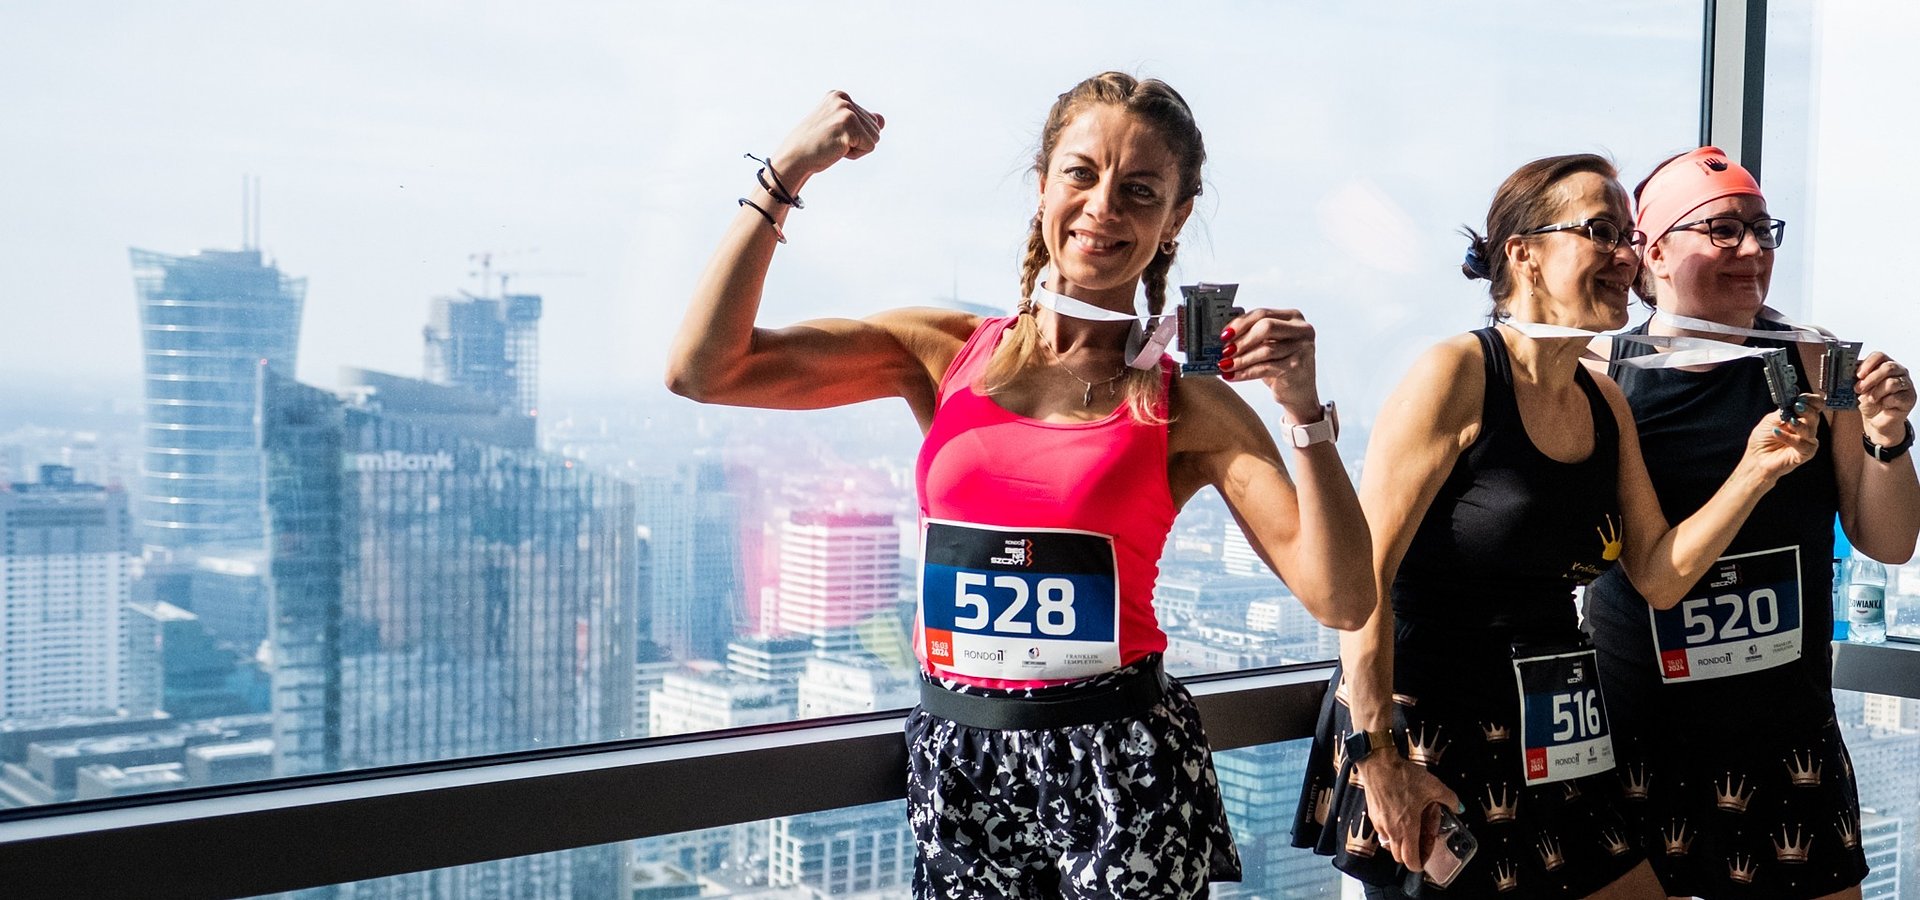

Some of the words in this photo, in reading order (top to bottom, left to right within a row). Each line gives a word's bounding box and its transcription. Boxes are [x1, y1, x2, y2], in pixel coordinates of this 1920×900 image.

[356, 449, 455, 471] mBank
[990, 557, 1025, 566] SZCZYT
[955, 572, 1076, 635] 528
[1682, 588, 1779, 645] 520
[931, 648, 949, 657] 2024
[1668, 664, 1685, 672] 2024
[1553, 689, 1601, 742] 516
